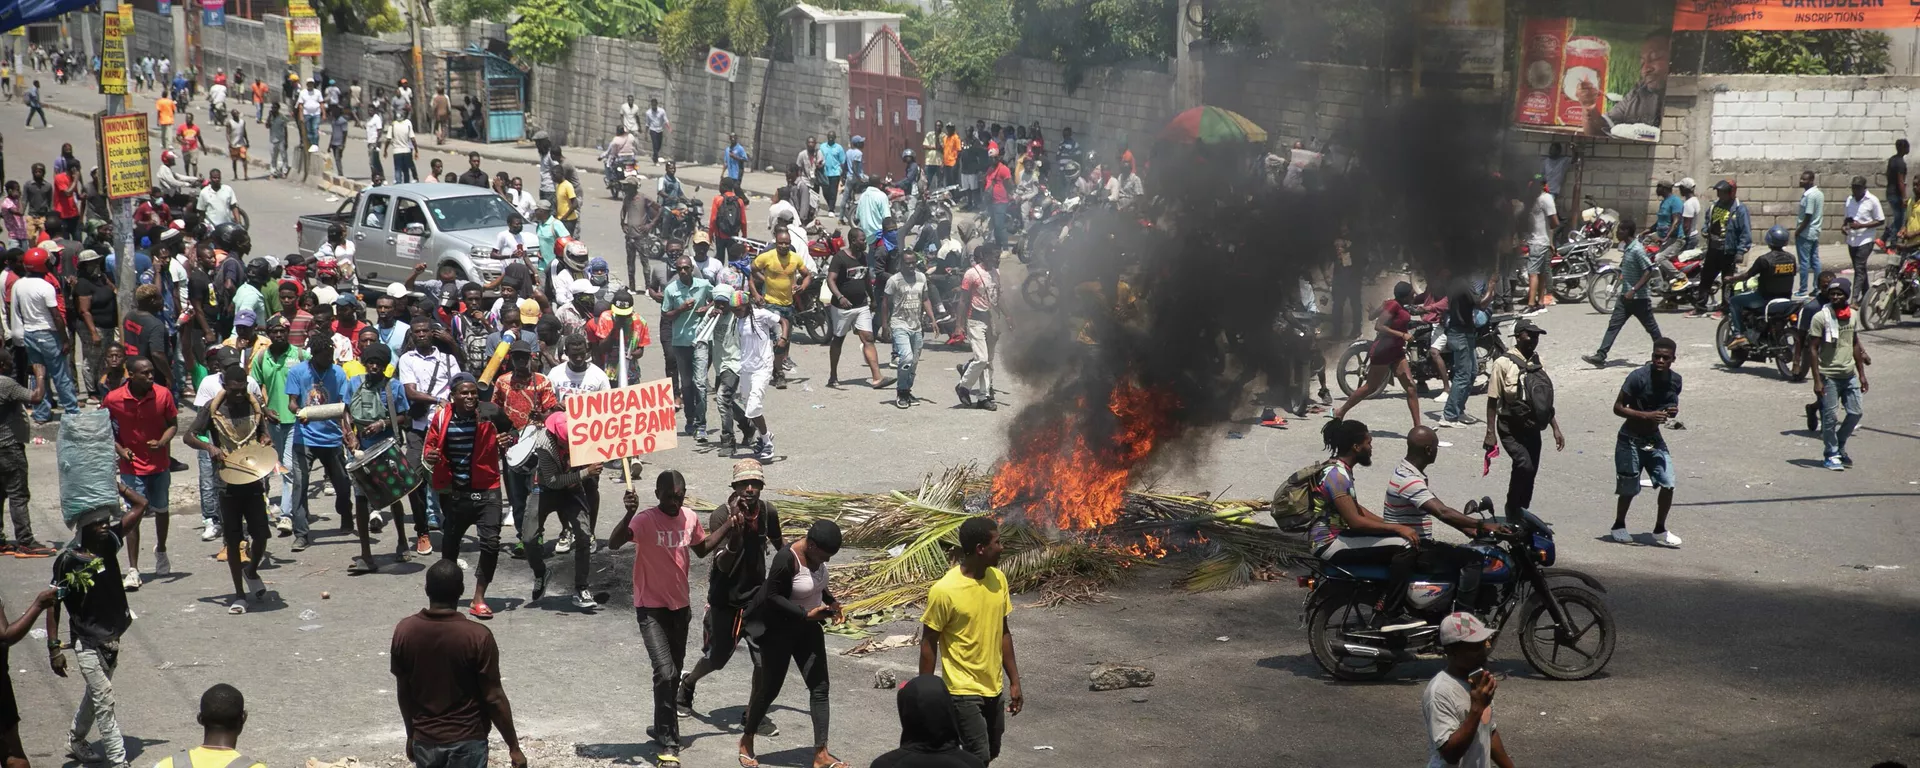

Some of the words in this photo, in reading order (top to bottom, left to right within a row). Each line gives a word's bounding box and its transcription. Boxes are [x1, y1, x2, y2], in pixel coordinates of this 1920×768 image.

[1795, 12, 1865, 22] INSCRIPTIONS
[105, 118, 145, 133] INNOVATION
[107, 132, 147, 145] INSTITUTE
[1775, 263, 1794, 273] PRESS
[568, 383, 673, 420] UNIBANK
